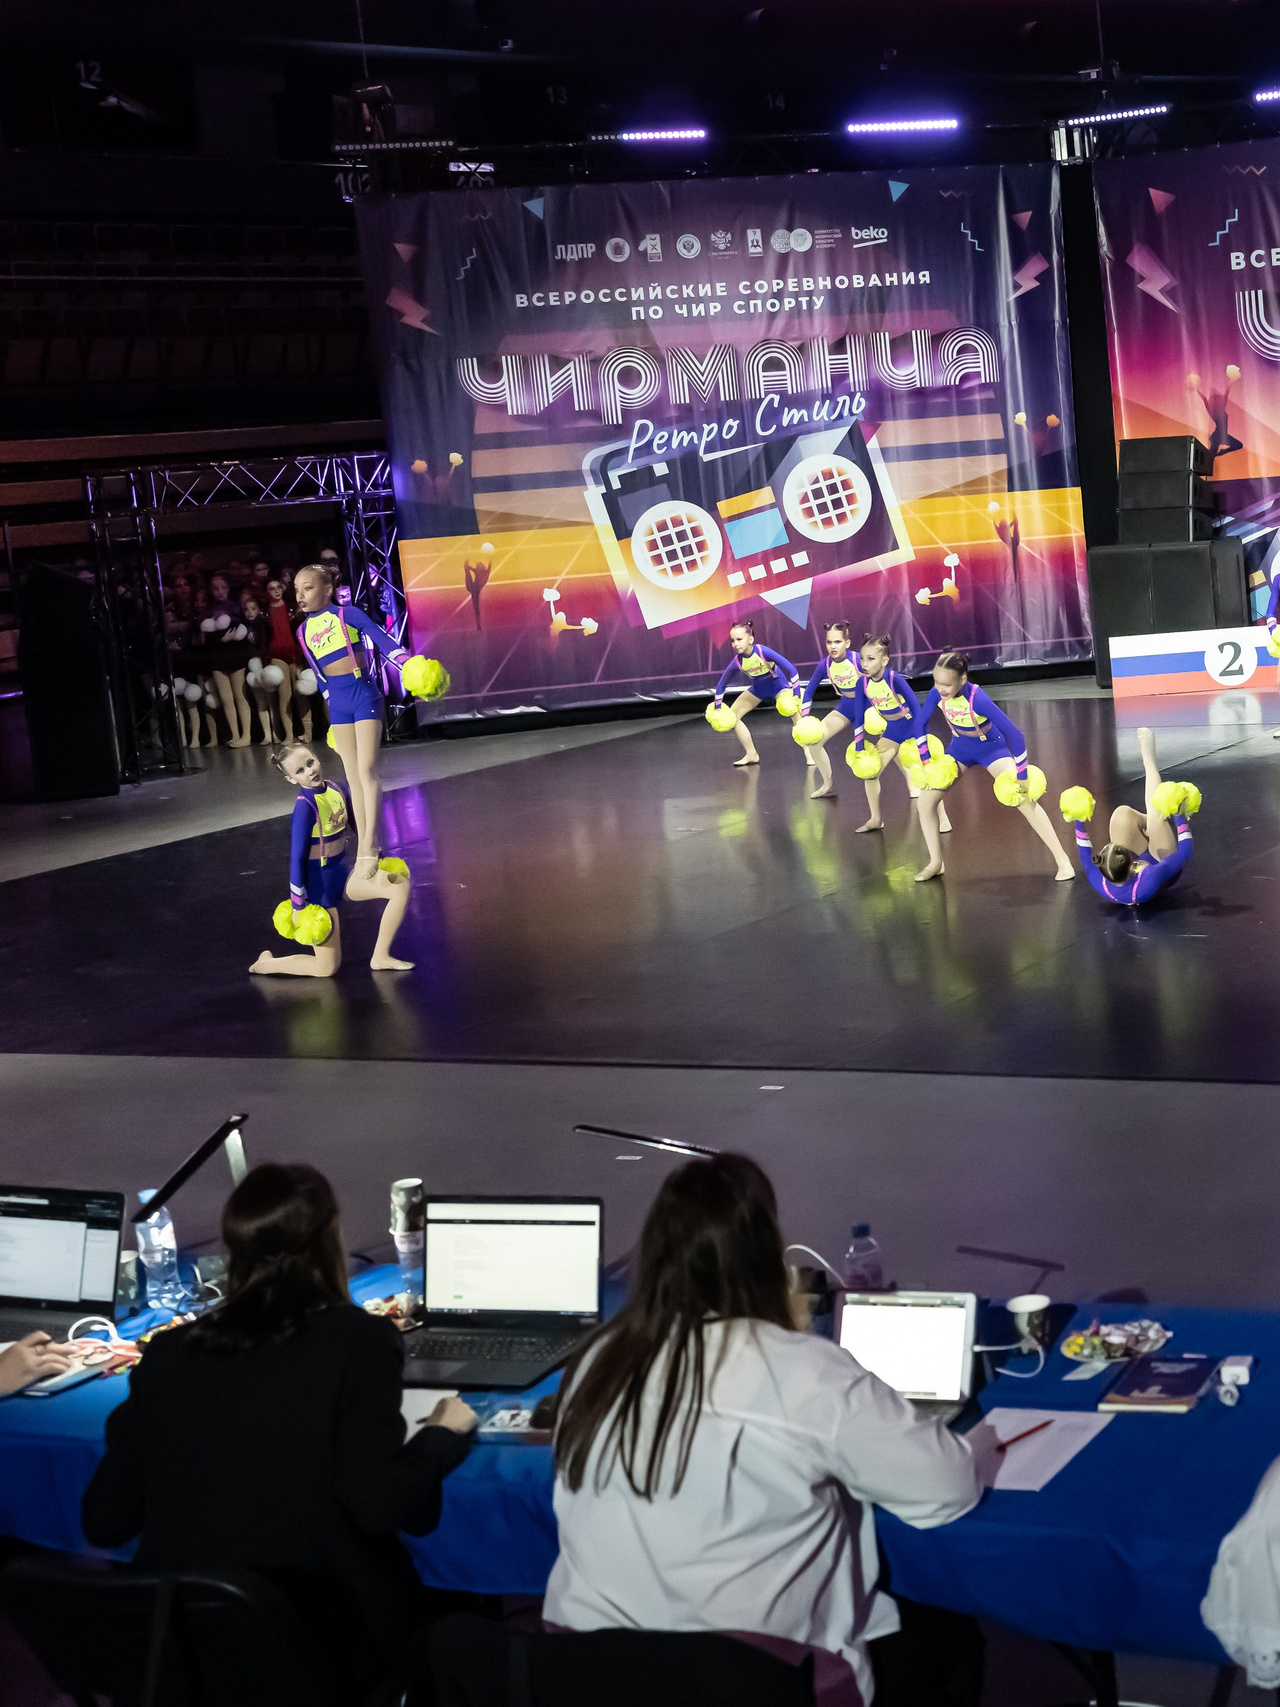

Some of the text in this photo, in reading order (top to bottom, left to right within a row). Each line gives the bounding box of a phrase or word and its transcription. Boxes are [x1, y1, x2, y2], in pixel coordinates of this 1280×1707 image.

[75, 59, 102, 82] 12
[546, 86, 568, 105] 13
[765, 92, 786, 110] 14
[850, 226, 889, 240] beko
[554, 243, 597, 262] ЛДПР
[515, 270, 931, 308] ВСЕРОССИЙСКИЕ СОРЕВНОВАНИЯ
[631, 295, 825, 321] ПО ЧИР СПОРТУ
[627, 392, 866, 464] Ретро Стиль
[1217, 641, 1244, 677] 2
